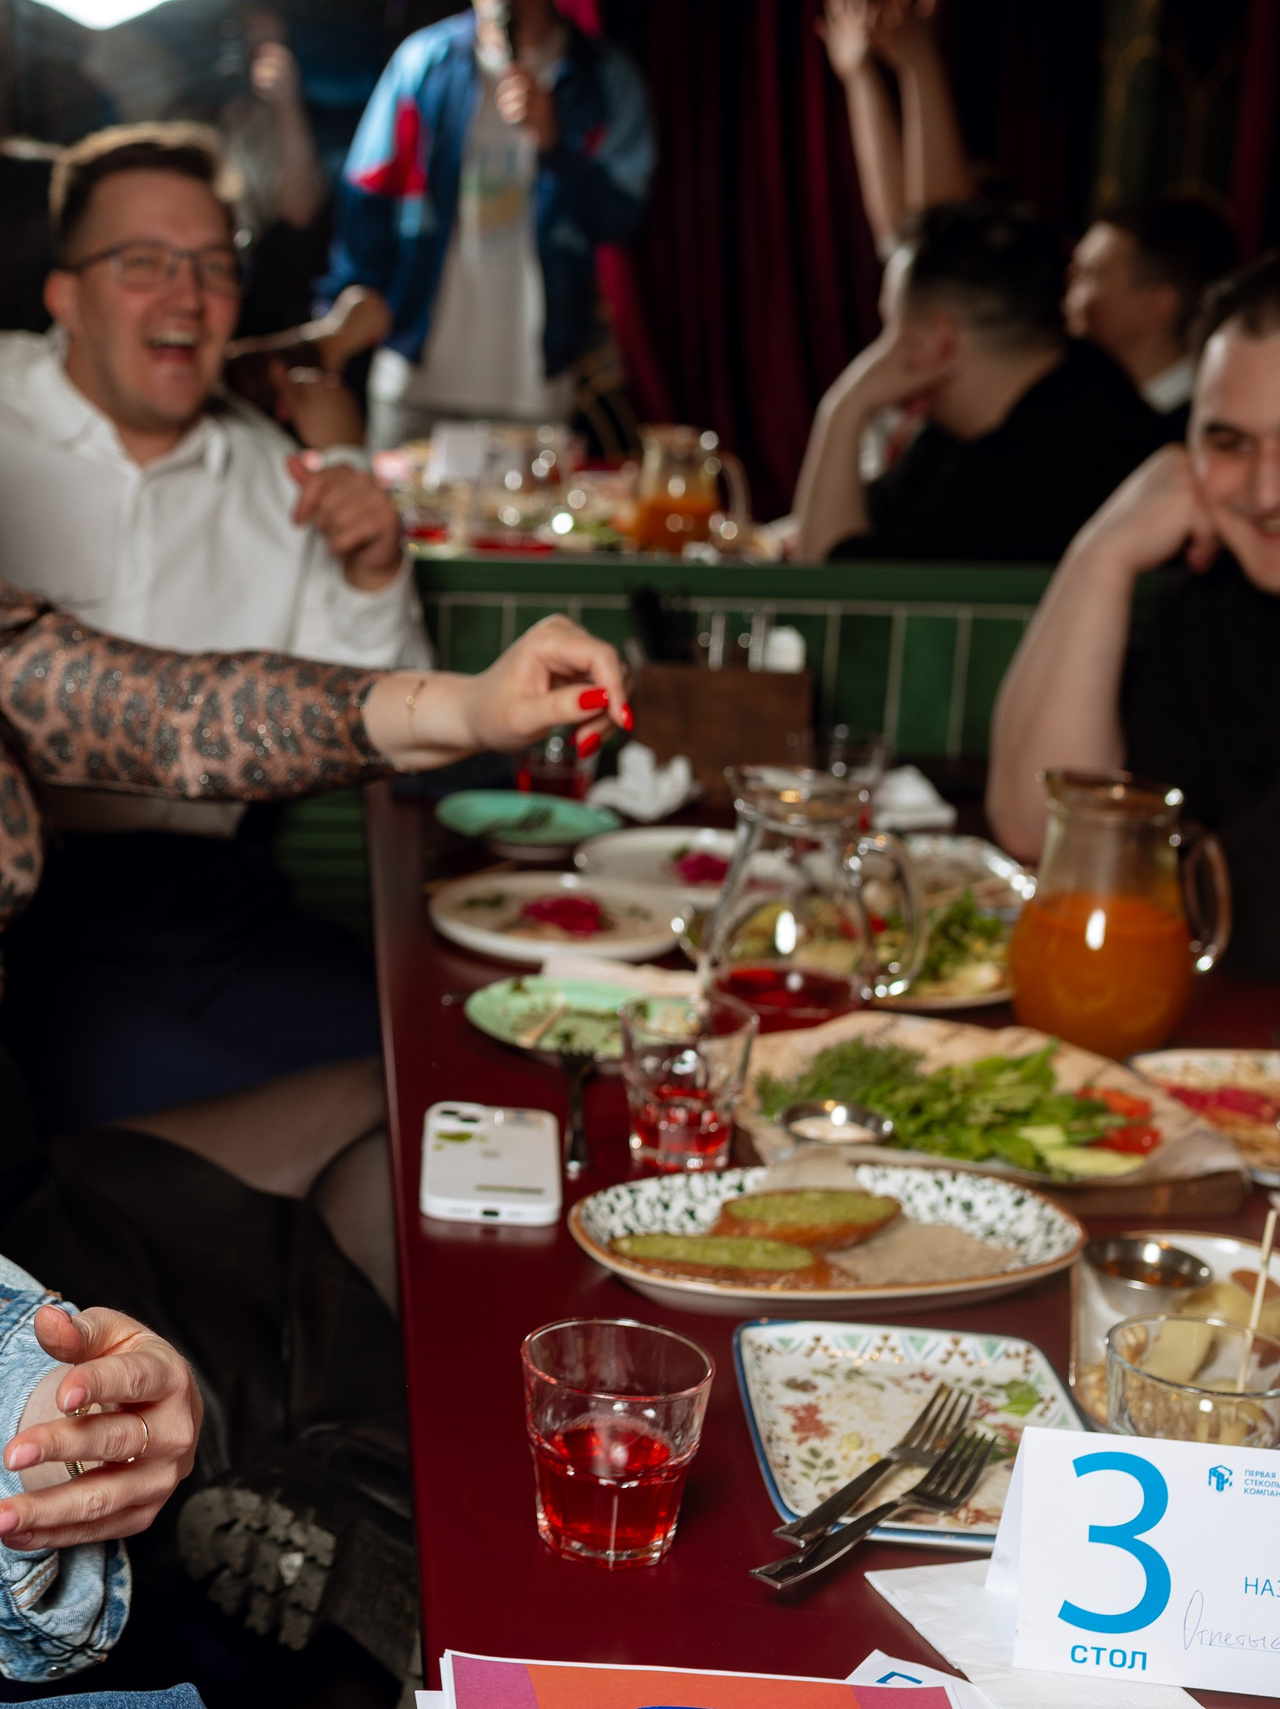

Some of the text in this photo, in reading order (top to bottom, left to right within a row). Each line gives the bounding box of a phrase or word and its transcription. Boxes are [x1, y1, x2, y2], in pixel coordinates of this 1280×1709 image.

[1245, 1469, 1276, 1479] ПЕРВАЯ
[1058, 1451, 1171, 1634] 3
[1070, 1645, 1147, 1670] СТОЛ
